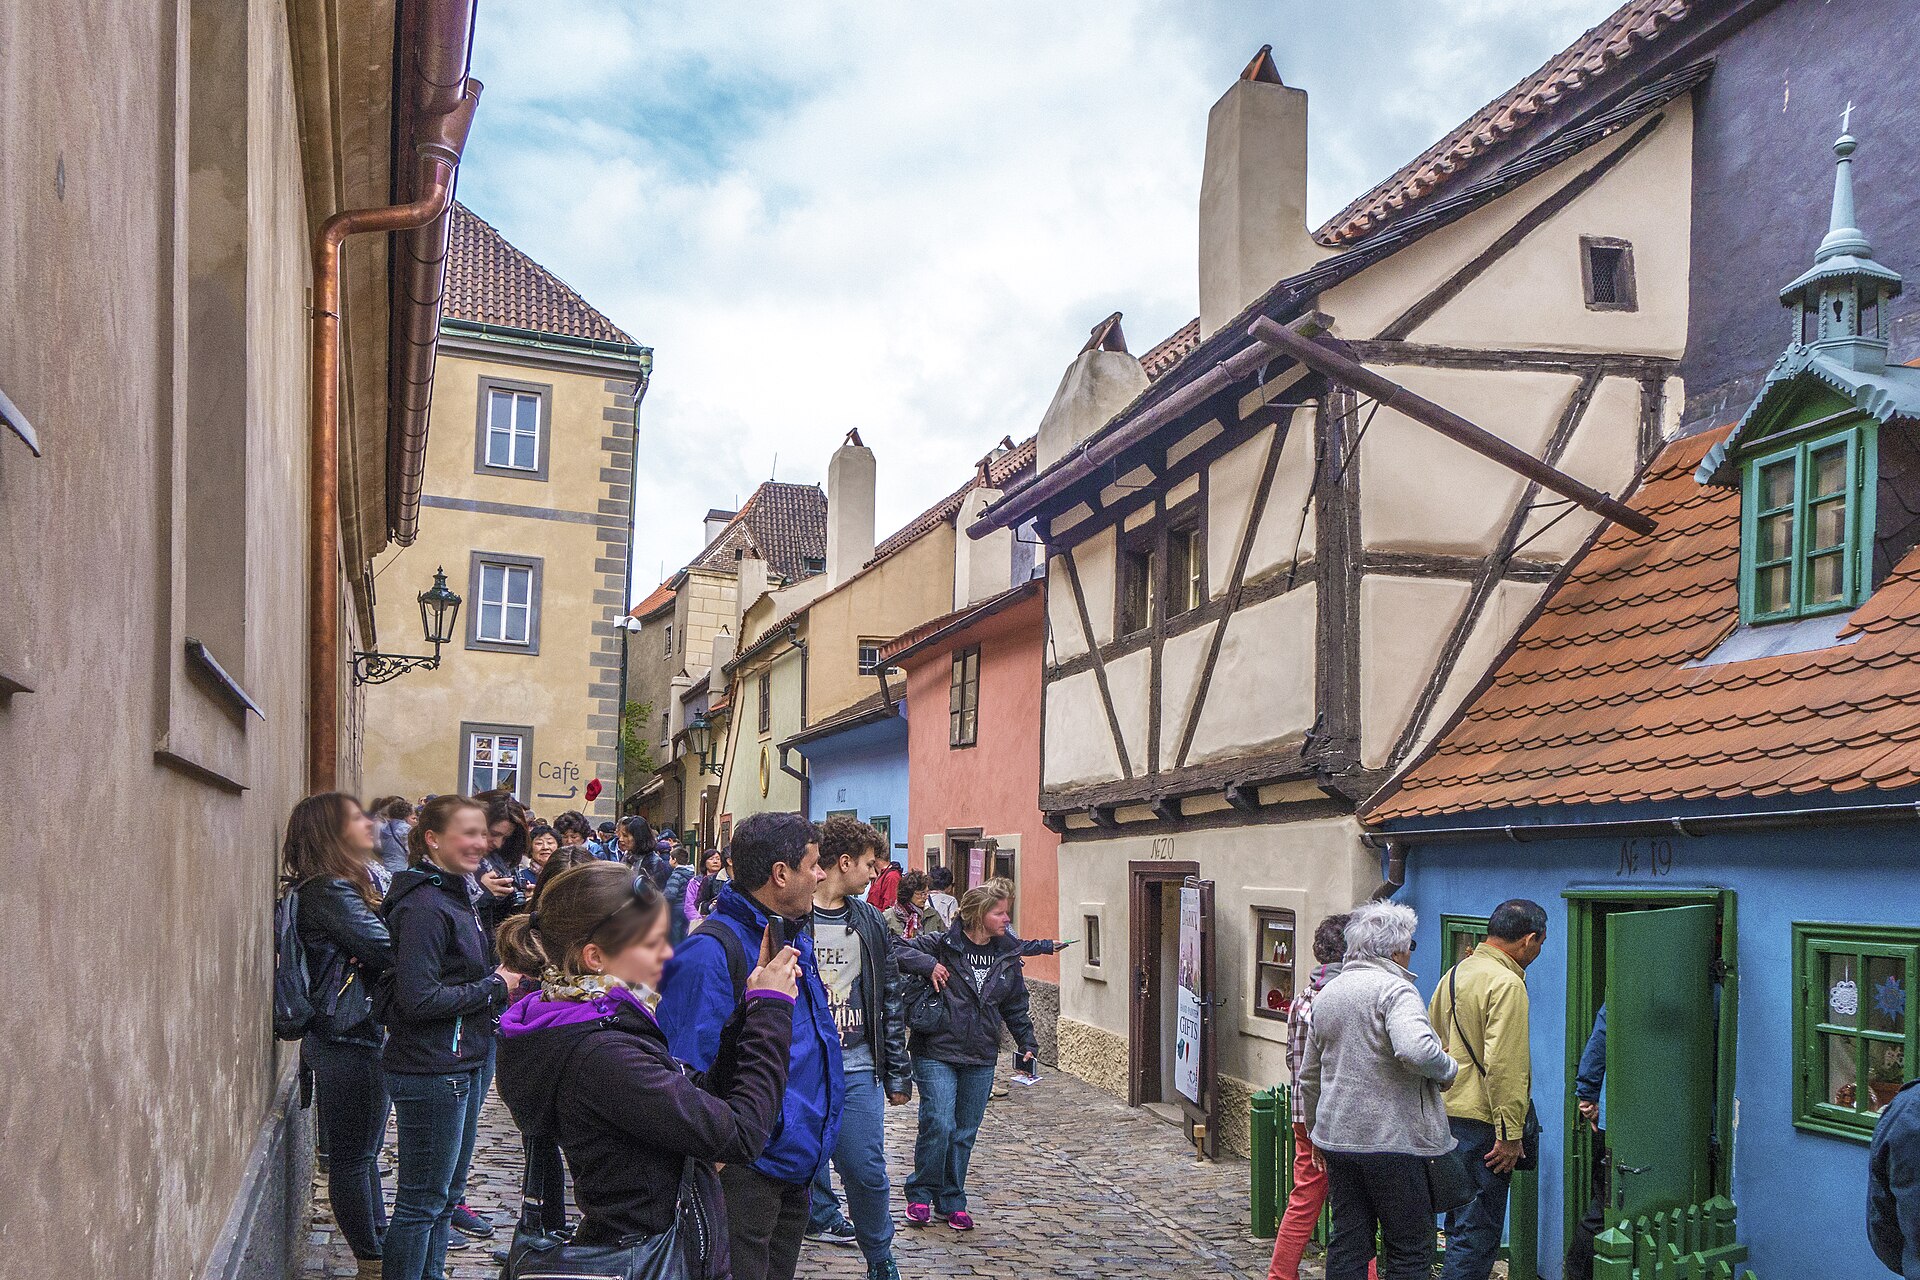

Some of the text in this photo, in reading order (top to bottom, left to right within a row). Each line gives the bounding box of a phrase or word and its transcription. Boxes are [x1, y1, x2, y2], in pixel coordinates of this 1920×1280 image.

[538, 761, 580, 785] Café
[1650, 840, 1672, 877] 19
[1180, 1016, 1198, 1041] GIFTS
